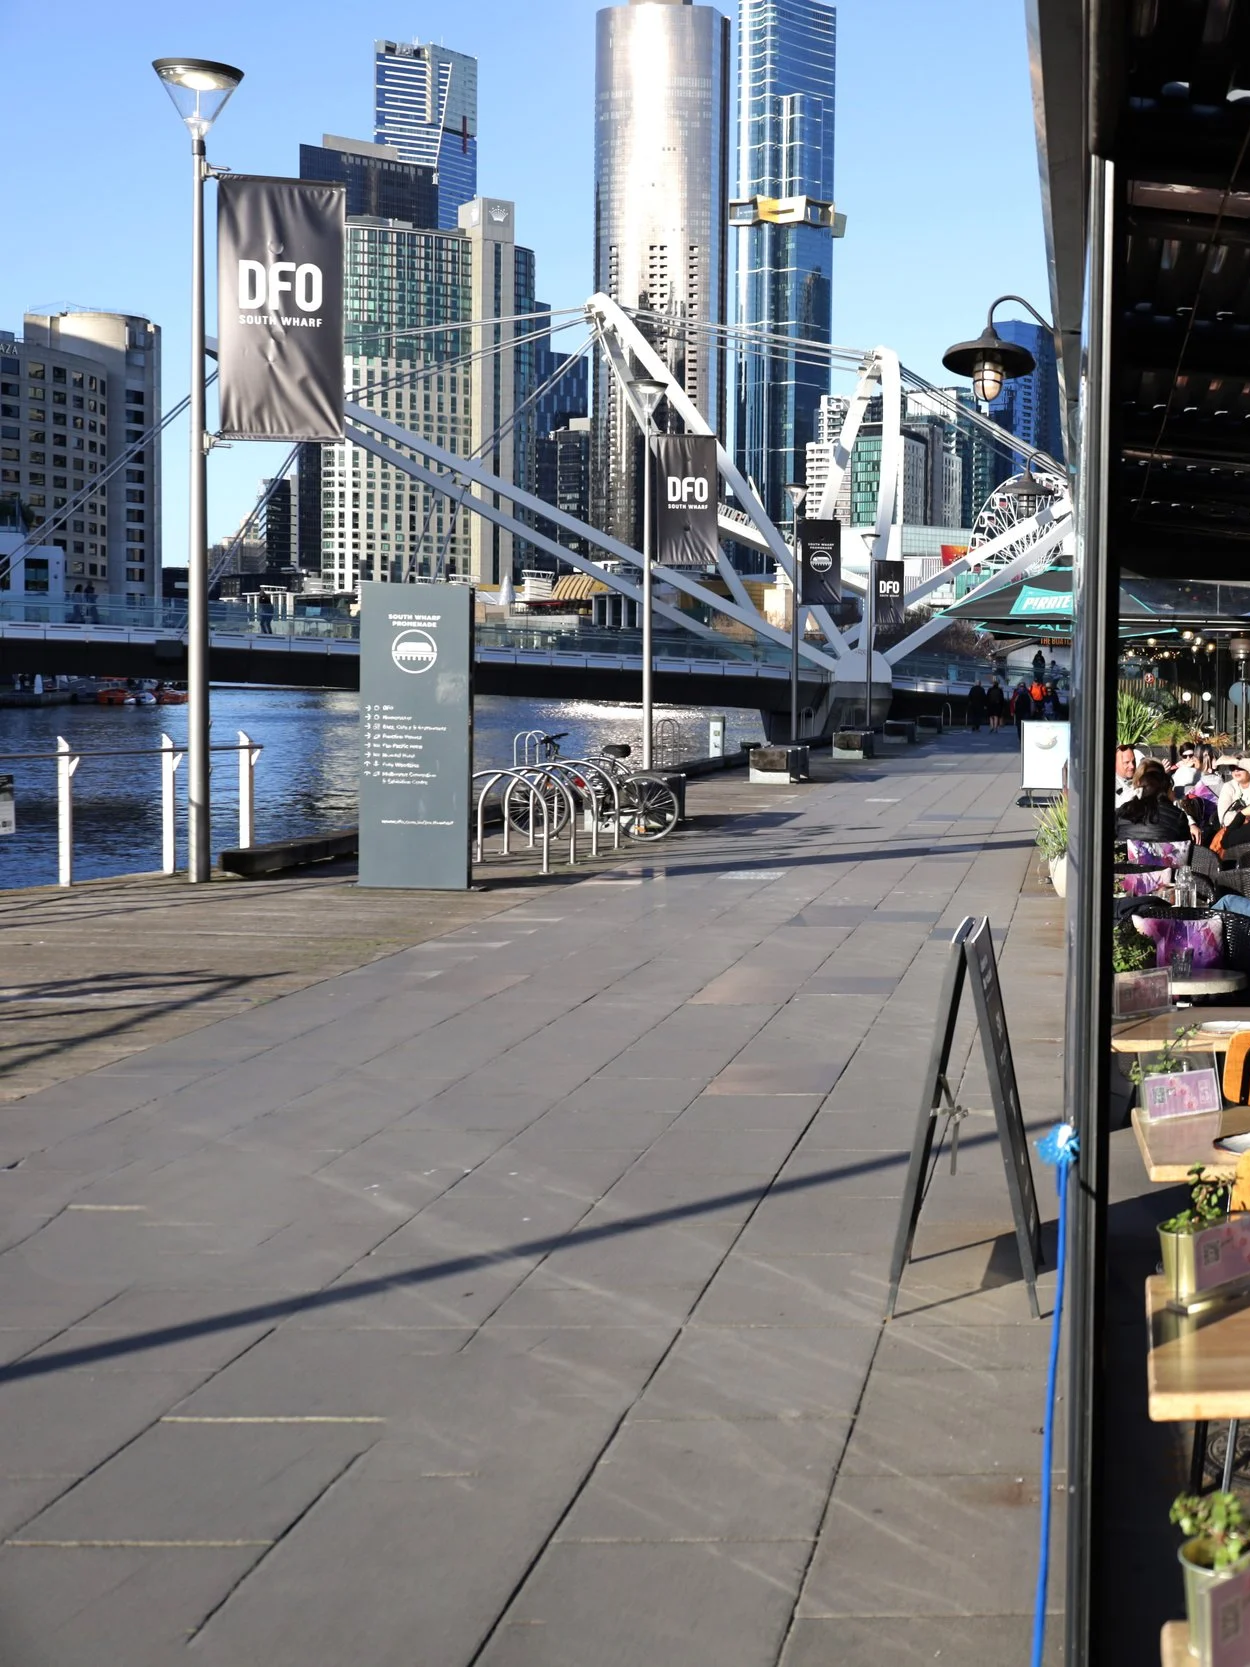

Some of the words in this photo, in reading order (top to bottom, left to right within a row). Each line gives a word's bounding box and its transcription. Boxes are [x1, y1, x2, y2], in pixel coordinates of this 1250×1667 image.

[239, 260, 322, 312] DFO
[239, 315, 277, 325] SOUTH
[281, 317, 322, 327] WHARF
[667, 476, 709, 502] DFO
[879, 580, 900, 594] DFO
